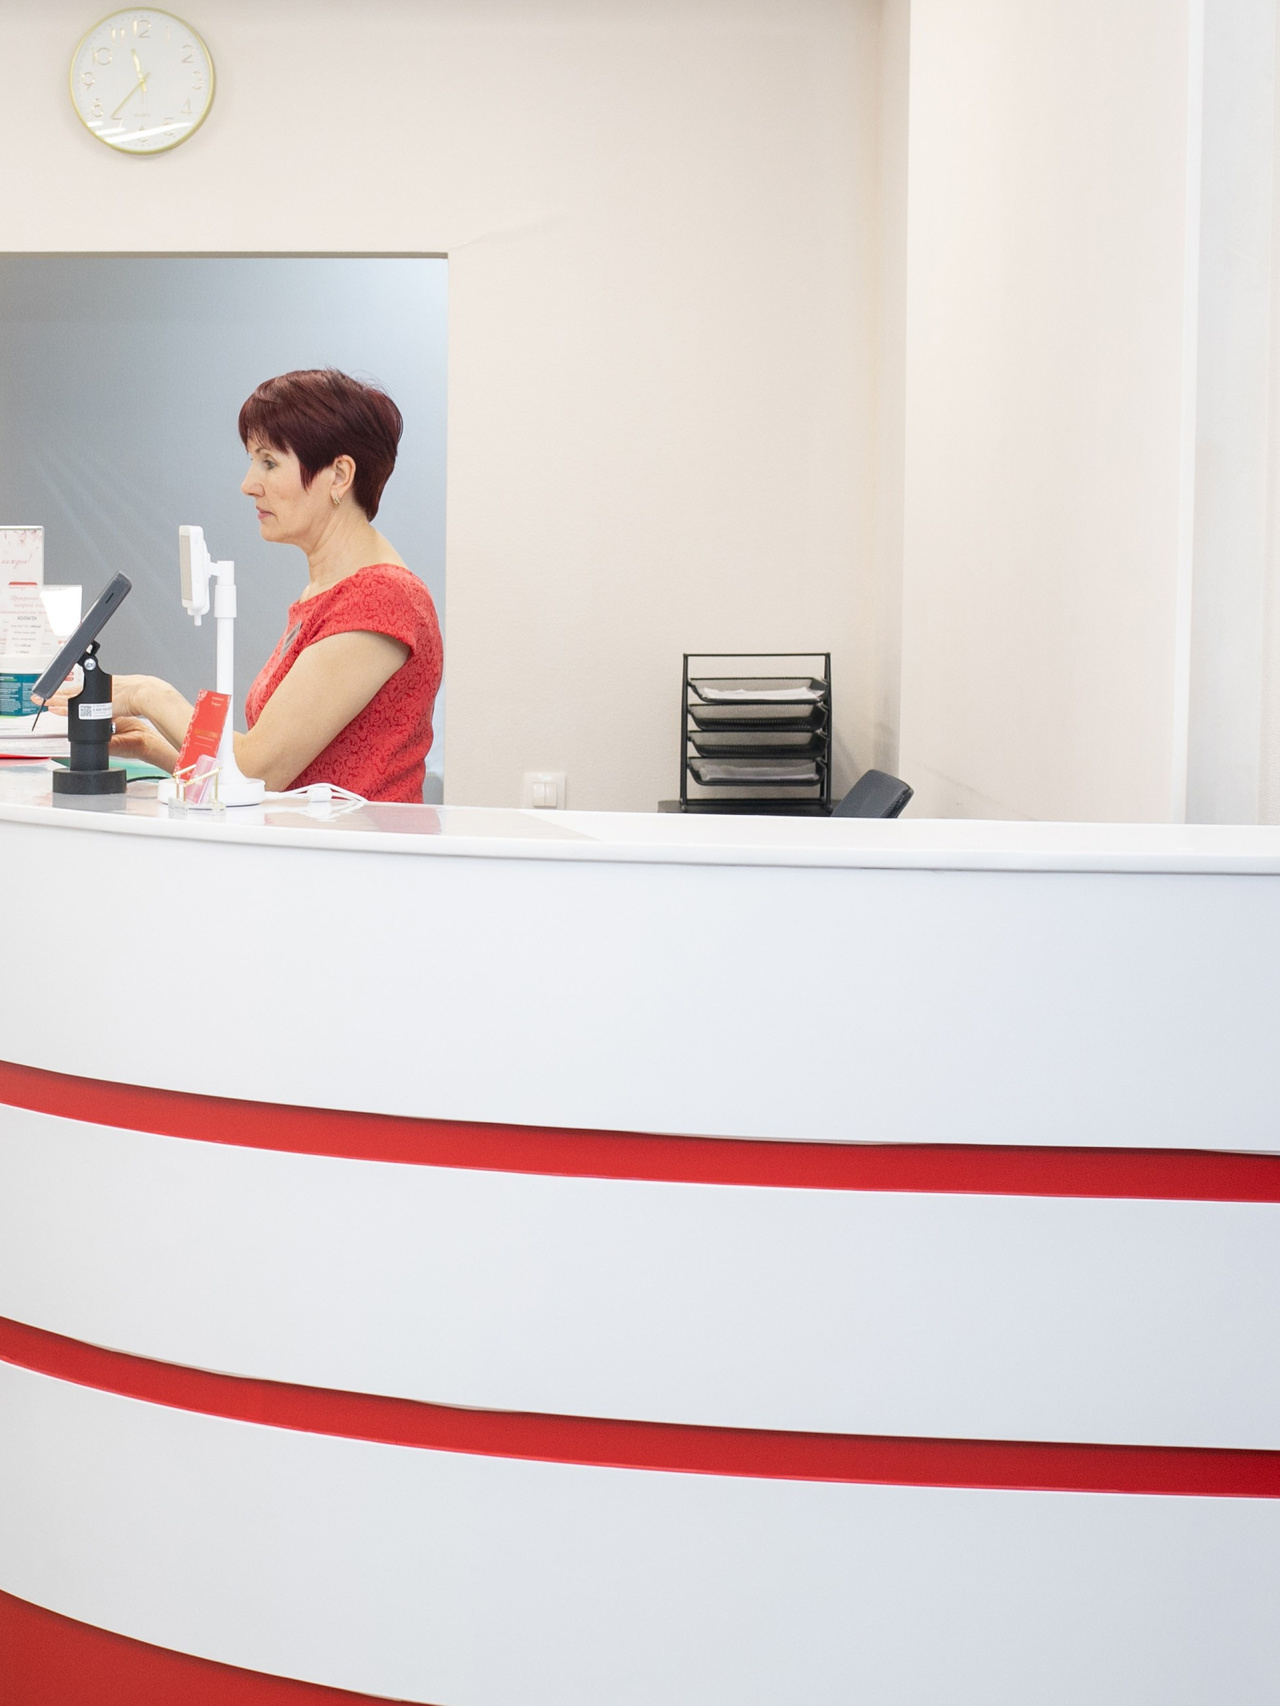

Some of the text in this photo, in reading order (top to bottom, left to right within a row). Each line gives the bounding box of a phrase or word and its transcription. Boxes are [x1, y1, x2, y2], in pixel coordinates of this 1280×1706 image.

[111, 27, 125, 44] 11
[133, 19, 151, 39] 12
[92, 47, 112, 66] 10
[181, 44, 195, 64] 2
[81, 71, 96, 91] 9
[192, 70, 204, 91] 3
[91, 98, 104, 118] 8
[181, 98, 192, 115] 4
[111, 117, 123, 130] 7
[162, 117, 175, 137] 5
